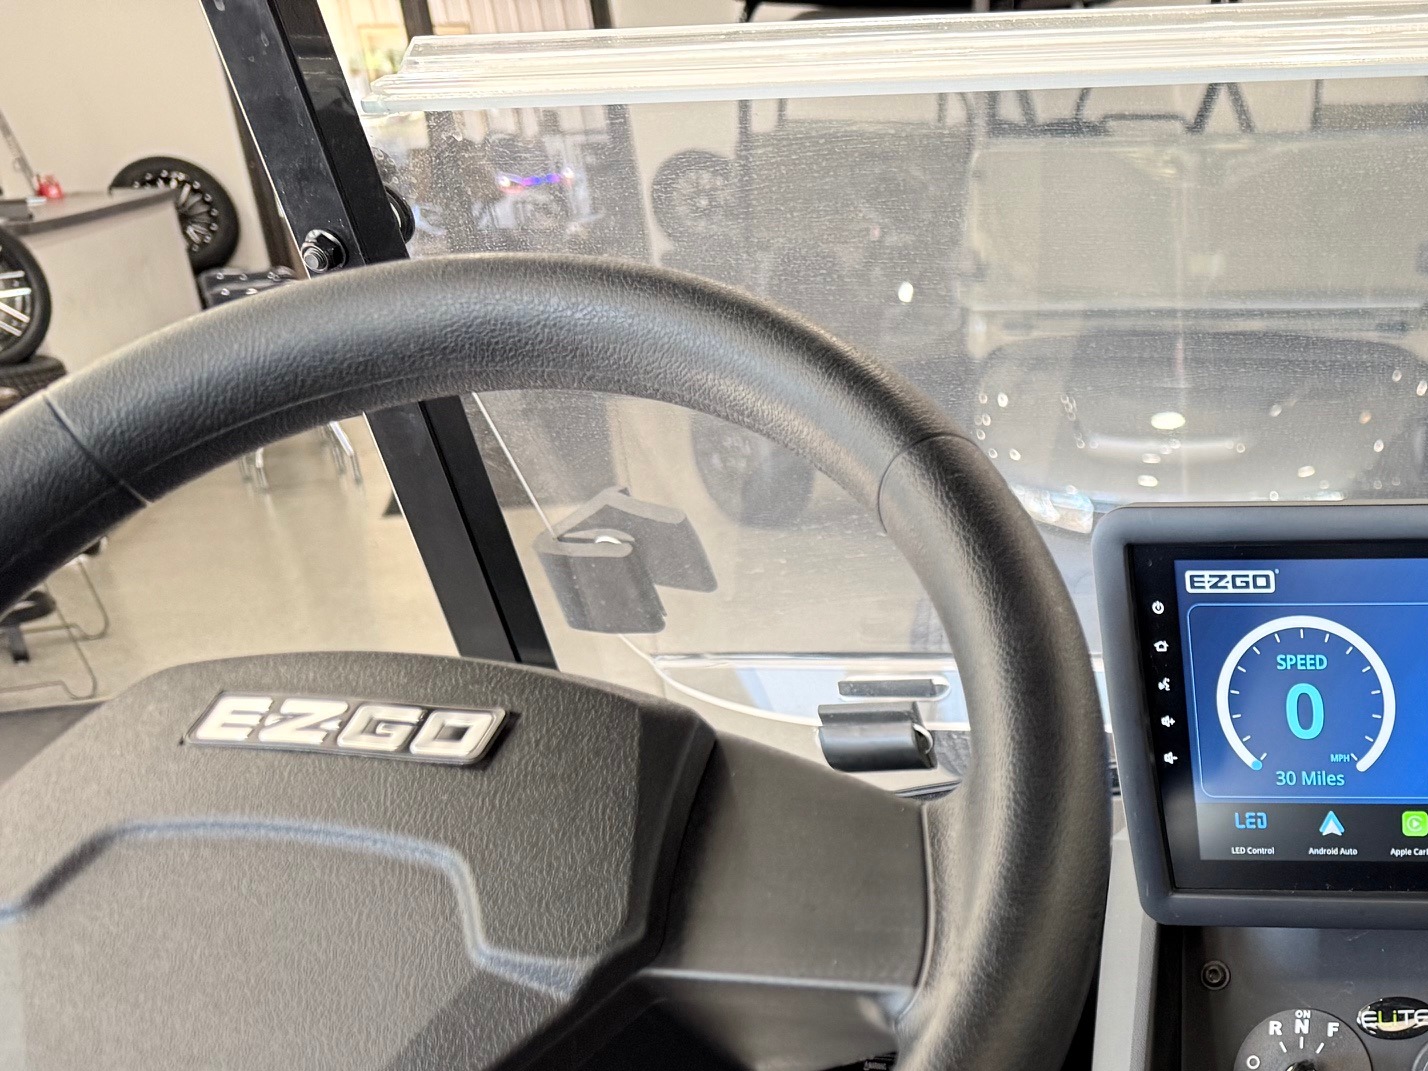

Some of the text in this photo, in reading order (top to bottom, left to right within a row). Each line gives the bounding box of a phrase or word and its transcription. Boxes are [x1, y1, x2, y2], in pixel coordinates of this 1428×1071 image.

[1188, 573, 1273, 591] EZGO
[1276, 653, 1328, 670] SPEED
[1285, 682, 1325, 740] 0
[195, 696, 494, 758] EZGO
[1330, 753, 1350, 763] MPH
[1275, 770, 1345, 786] 30 Miles
[1234, 811, 1268, 830] LED
[1231, 846, 1275, 855] LED Control
[1308, 846, 1358, 856] Android Auto
[1390, 847, 1412, 857] Apple
[1295, 1010, 1311, 1019] ON
[1269, 1019, 1340, 1037] R N F
